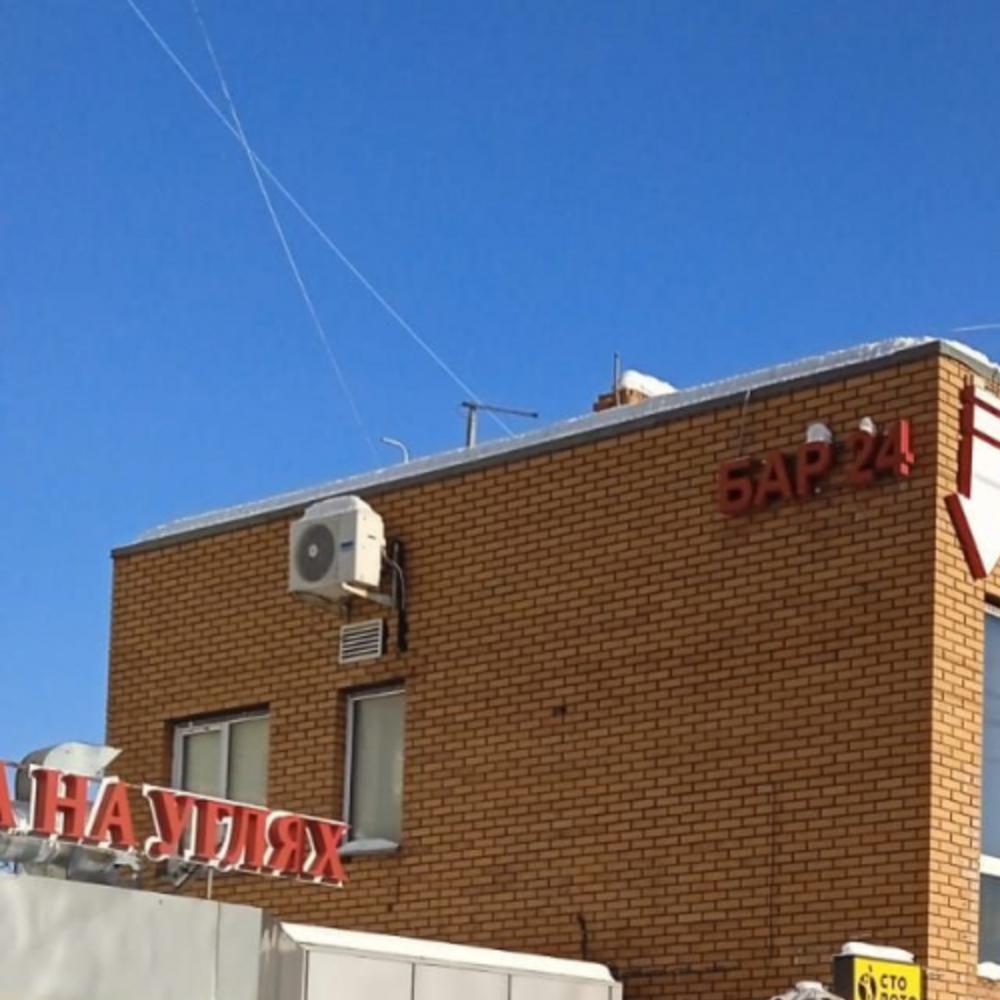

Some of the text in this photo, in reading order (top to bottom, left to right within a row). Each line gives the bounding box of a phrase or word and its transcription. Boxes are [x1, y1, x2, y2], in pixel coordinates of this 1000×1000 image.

[715, 440, 834, 517] БАР
[30, 764, 138, 851] НА
[142, 783, 350, 888] УГЛЯХ
[880, 973, 907, 991] СТО
